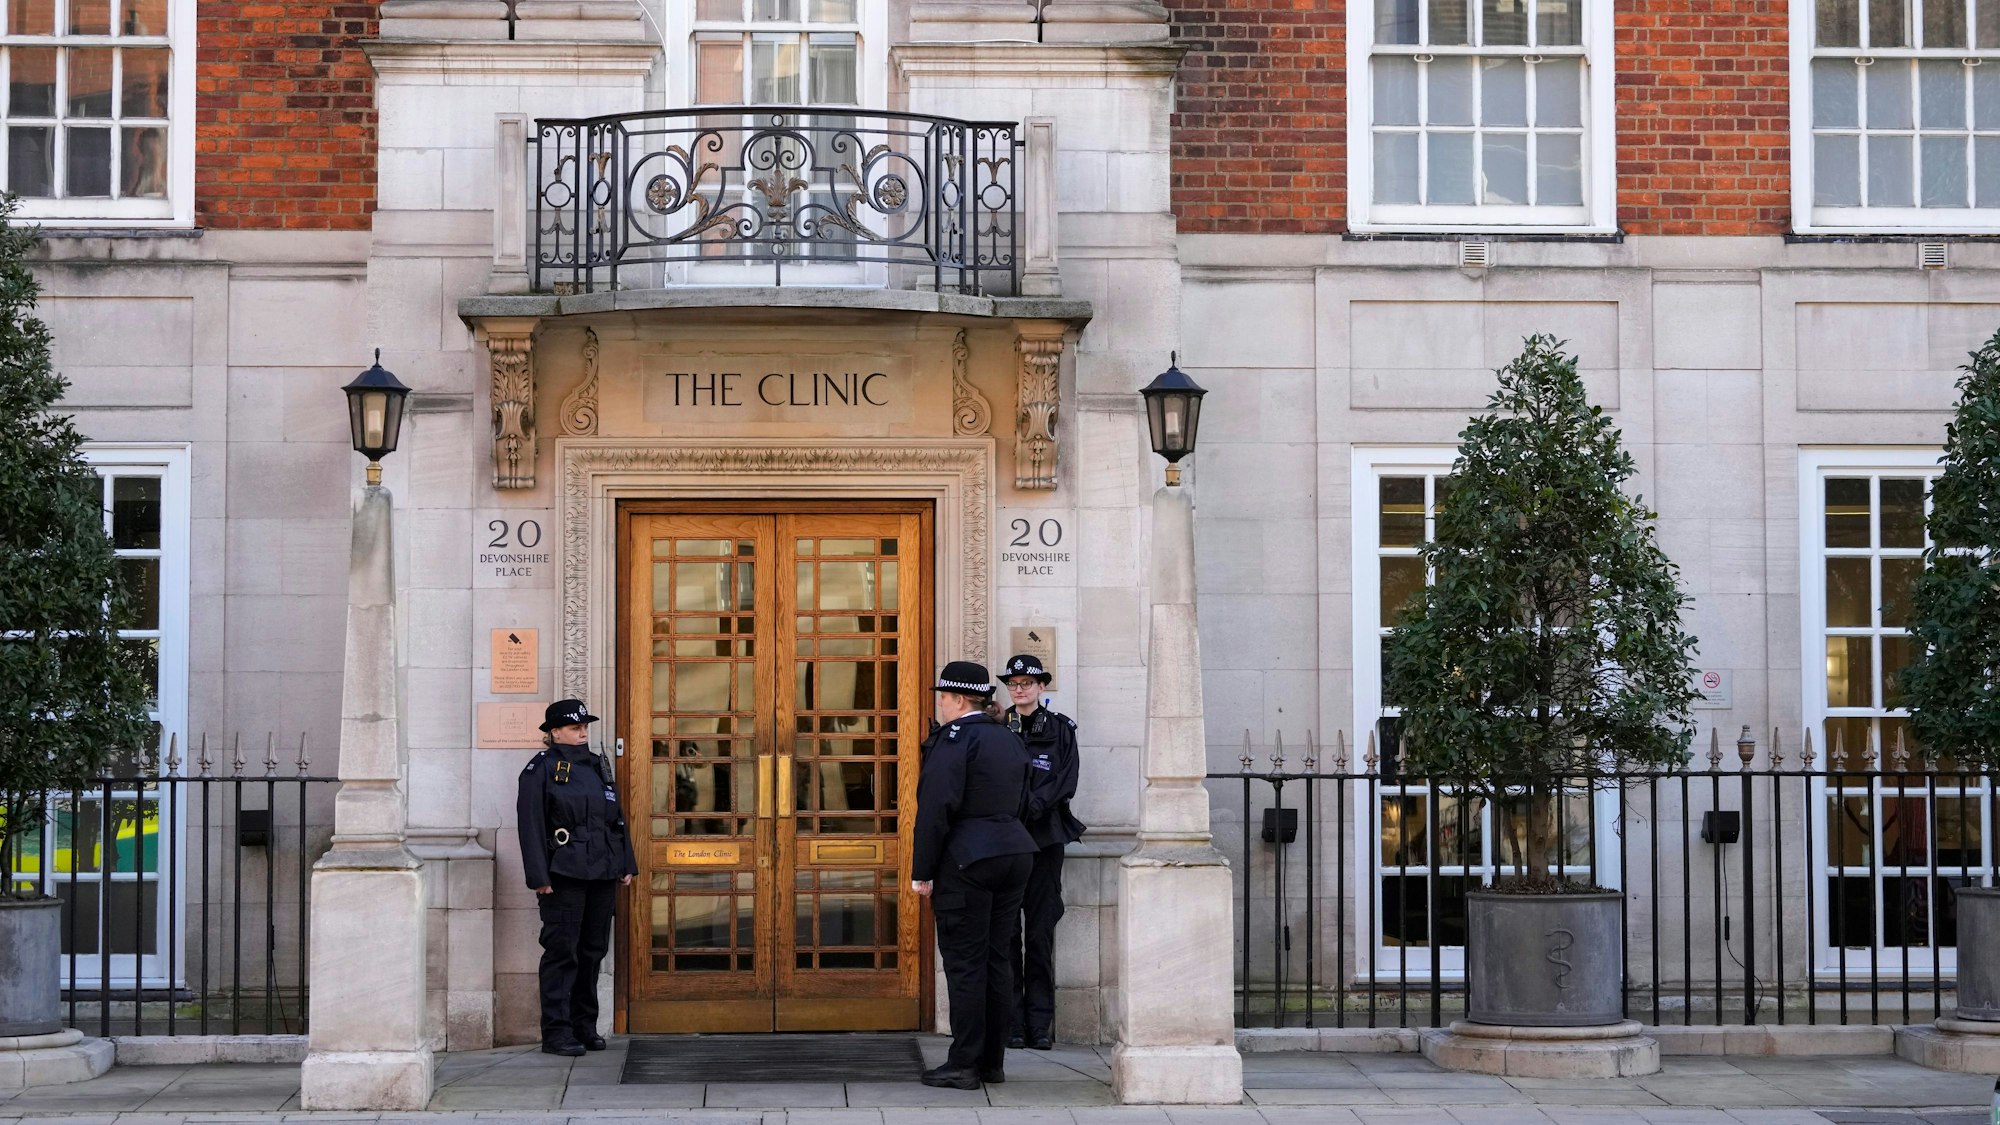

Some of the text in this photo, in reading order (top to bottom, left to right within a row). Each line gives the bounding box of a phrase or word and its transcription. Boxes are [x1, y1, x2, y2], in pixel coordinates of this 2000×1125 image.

[666, 372, 888, 407] THE CLINIC
[488, 519, 542, 549] 20
[1009, 518, 1063, 548] 20
[480, 554, 550, 563] DEVONSHIRE
[1001, 552, 1071, 563] DEVONSHIRE
[496, 567, 532, 577] PLACE
[1017, 565, 1054, 576] PLACE
[673, 849, 733, 858] The London Clinic
